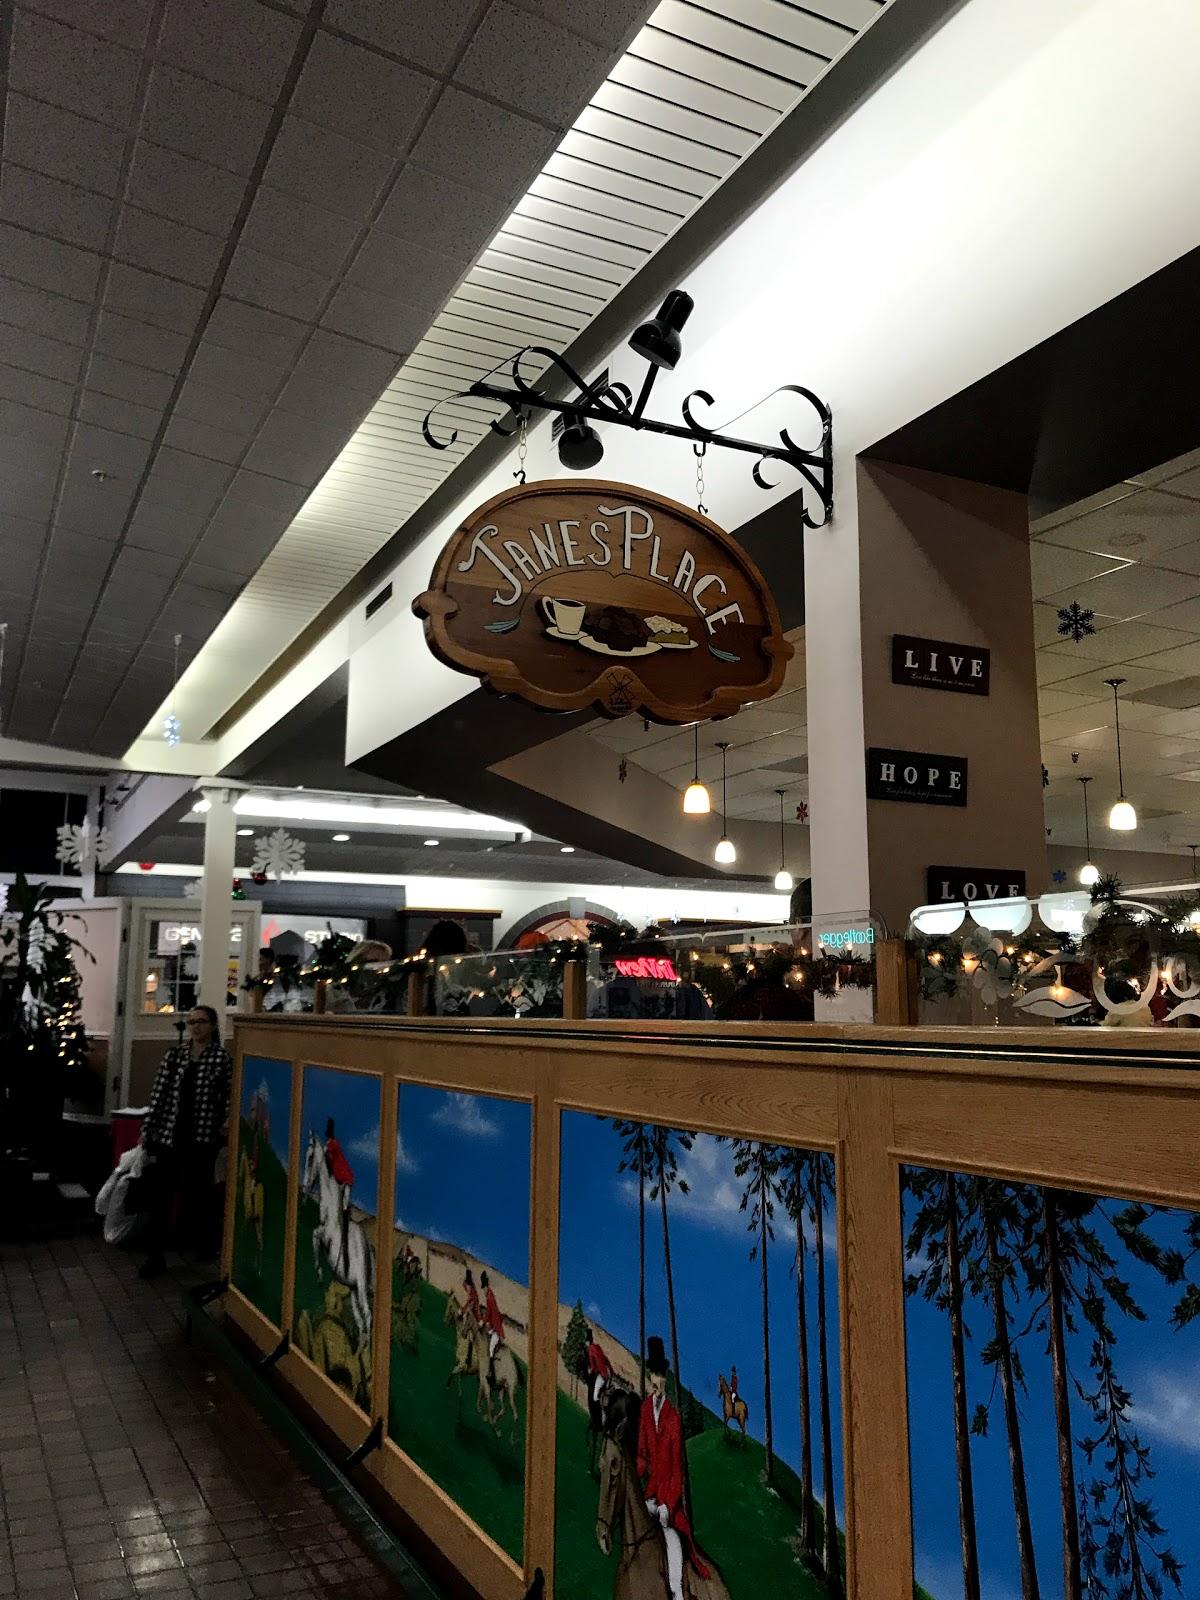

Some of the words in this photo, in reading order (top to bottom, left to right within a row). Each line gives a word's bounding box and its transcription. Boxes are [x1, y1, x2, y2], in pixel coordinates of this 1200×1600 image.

[457, 520, 612, 606] JANES
[597, 504, 744, 636] PLACE
[904, 649, 983, 678] LIVE
[880, 762, 961, 790] HOPE
